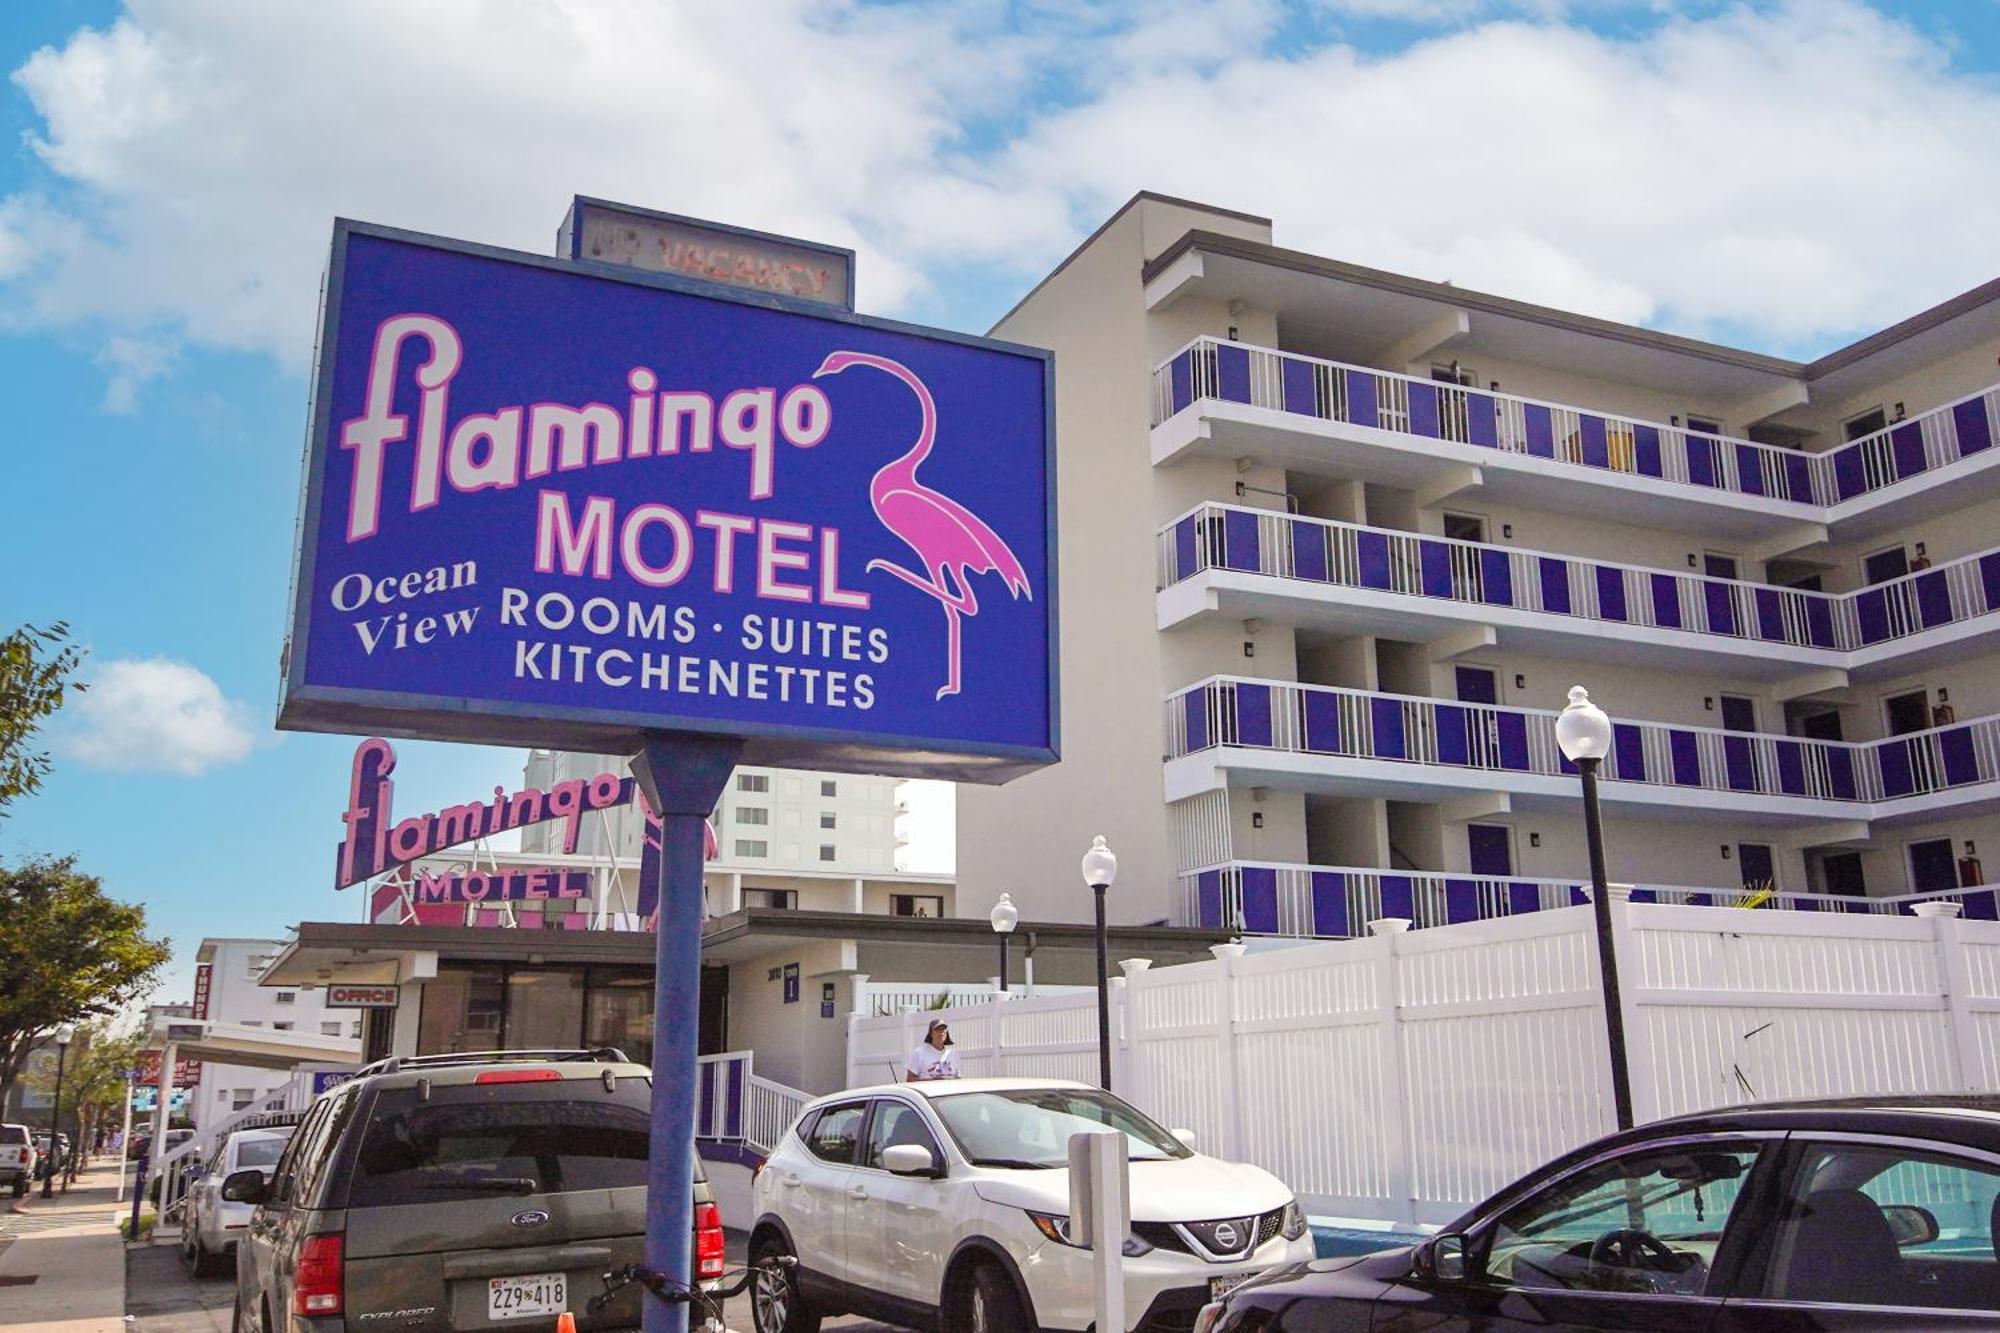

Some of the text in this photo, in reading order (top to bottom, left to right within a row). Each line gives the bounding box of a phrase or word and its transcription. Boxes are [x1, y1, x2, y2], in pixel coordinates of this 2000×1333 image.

[534, 490, 871, 610] MOTEL
[330, 560, 478, 612] Ocean
[353, 606, 481, 656] View
[500, 587, 889, 664] ROOMS SUITES
[514, 640, 875, 710] KITCHENETTES
[418, 866, 583, 903] MOTEL
[334, 989, 395, 1003] OFFICE
[534, 1283, 563, 1305] 418
